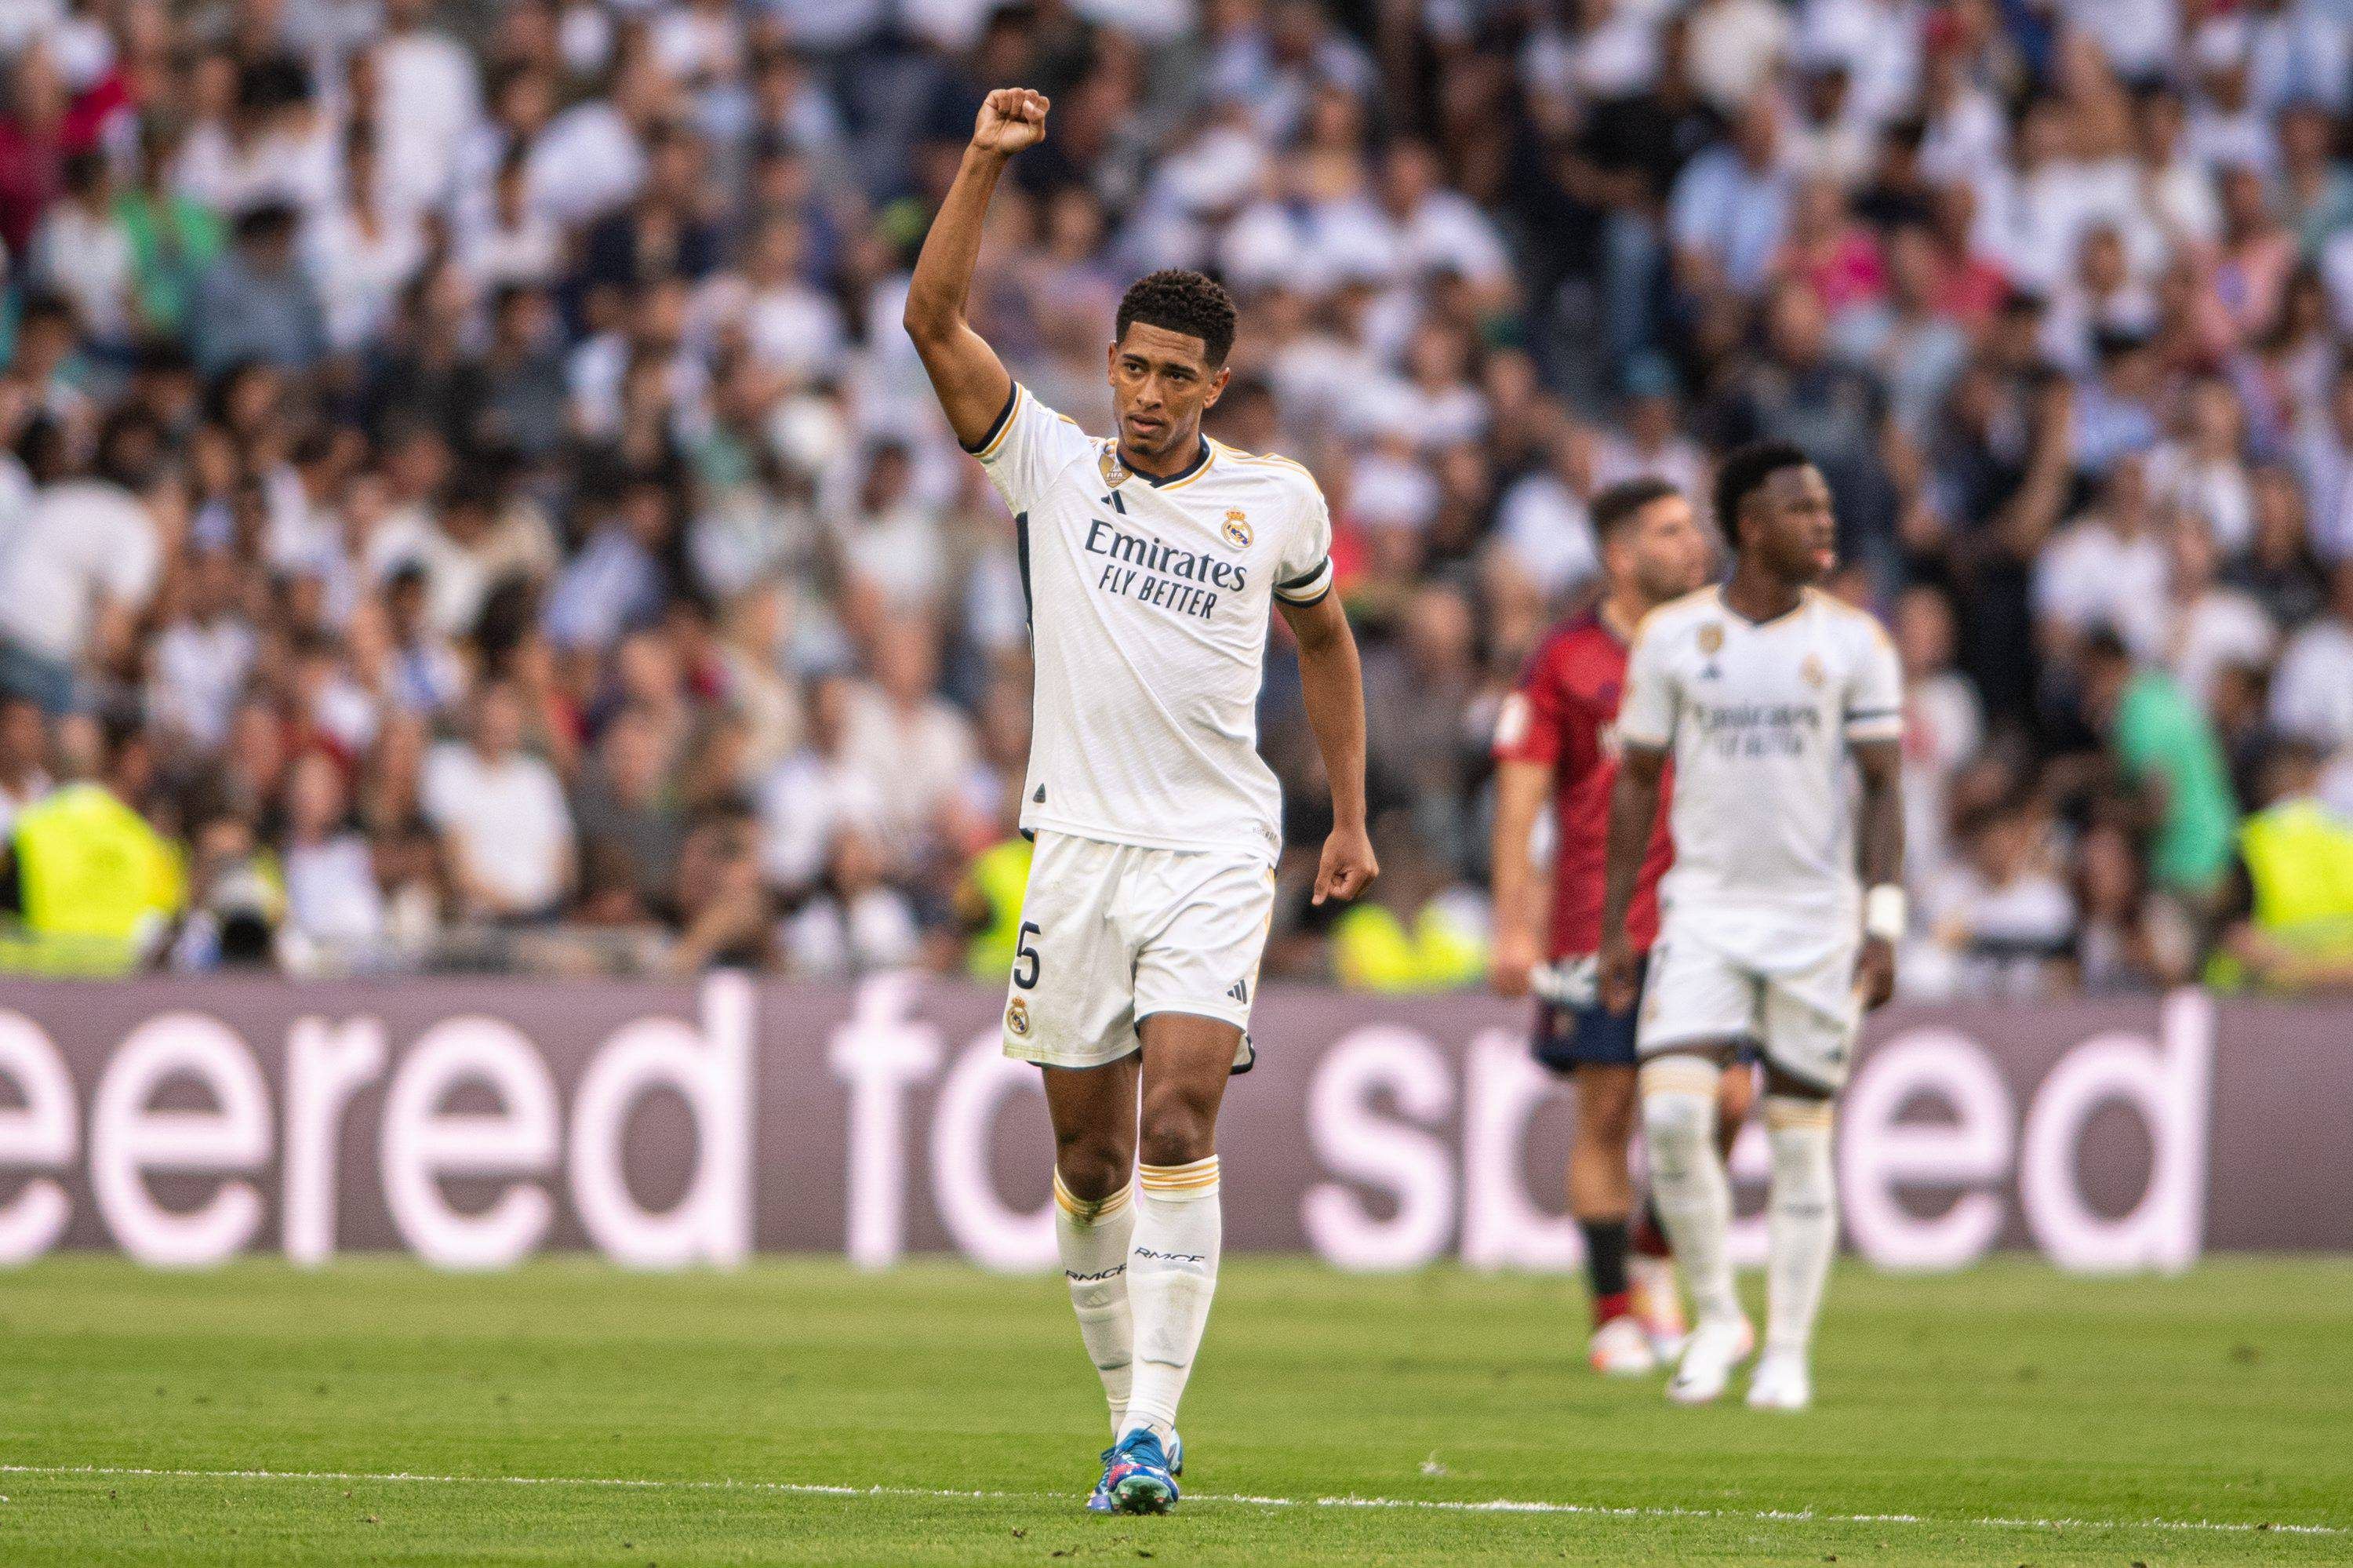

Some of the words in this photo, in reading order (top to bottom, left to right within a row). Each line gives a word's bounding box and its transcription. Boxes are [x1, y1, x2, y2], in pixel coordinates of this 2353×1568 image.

[1106, 471, 1124, 479] FIFA
[1085, 518, 1247, 592] Emirates
[1099, 564, 1136, 595] FLY
[1138, 575, 1217, 619] BETTER
[1013, 921, 1042, 989] 5
[830, 970, 1142, 1275] fo
[1135, 1247, 1205, 1263] RMCF
